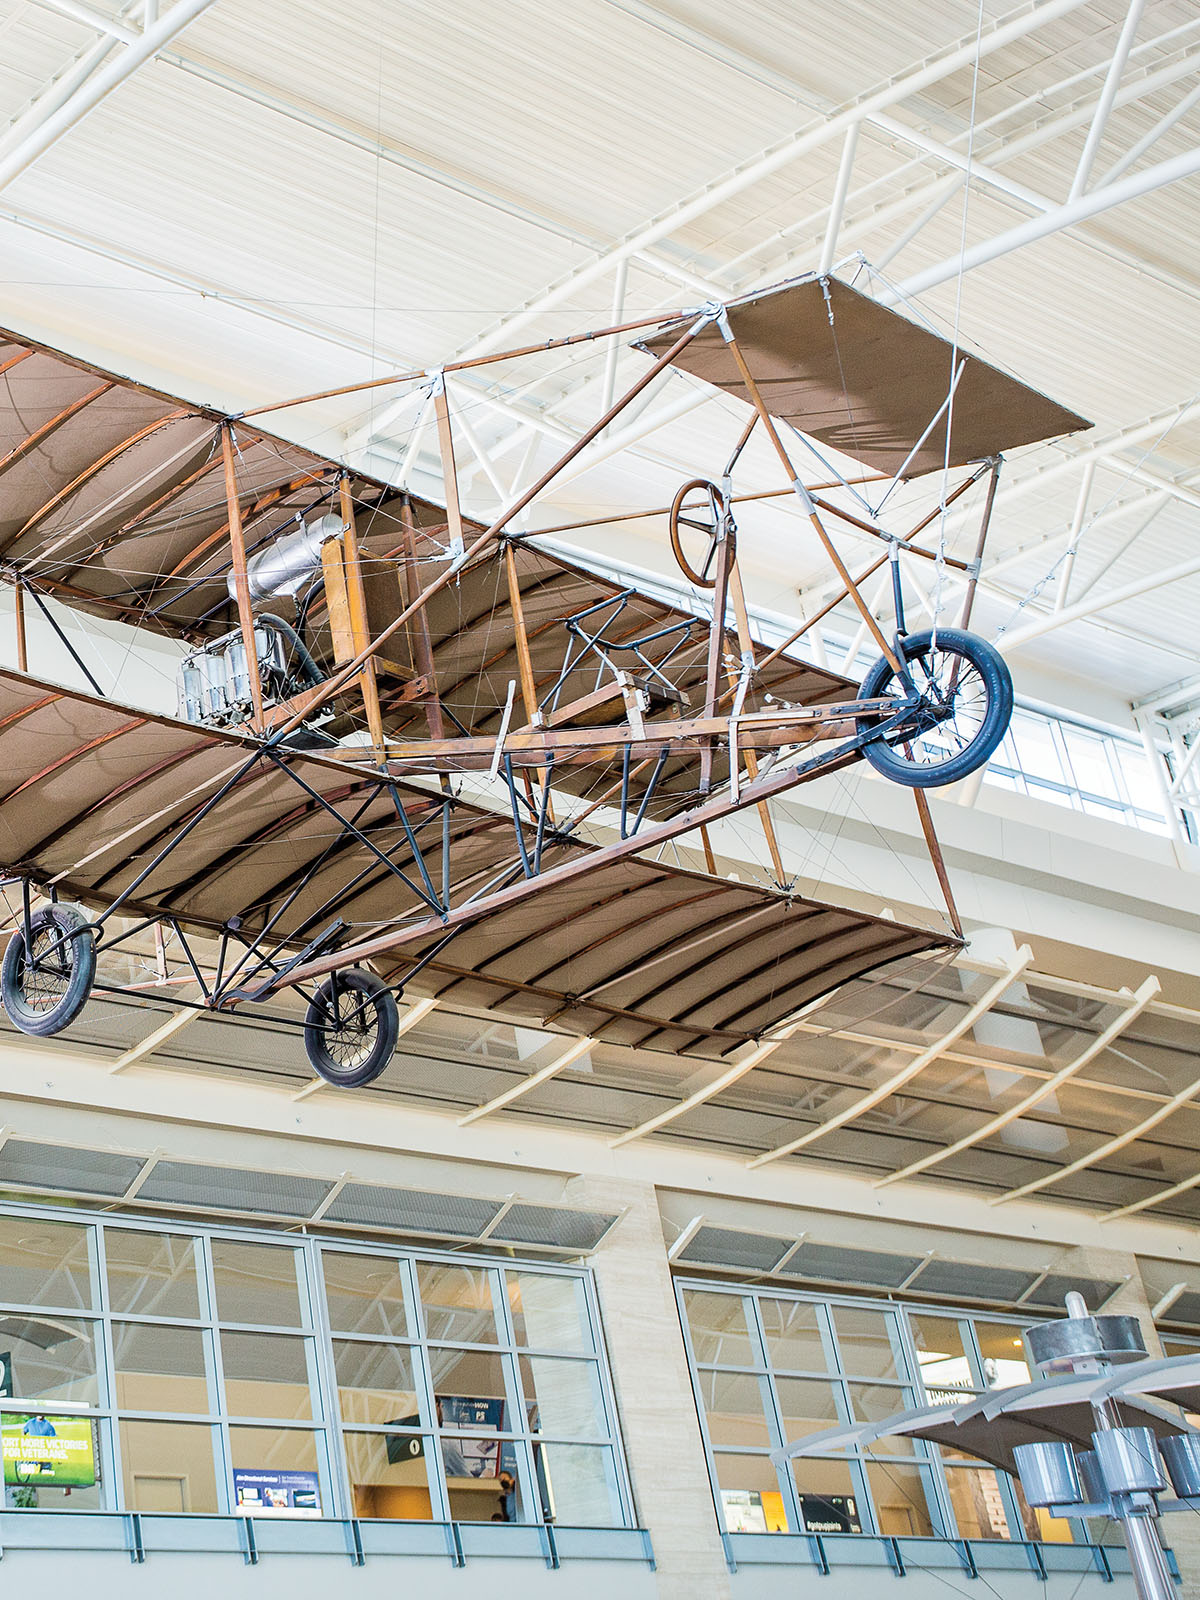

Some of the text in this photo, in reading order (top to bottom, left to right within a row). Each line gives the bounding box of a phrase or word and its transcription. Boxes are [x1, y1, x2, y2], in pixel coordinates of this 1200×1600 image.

[20, 1438, 45, 1449] MORE
[47, 1440, 88, 1450] VICTORIES
[4, 1448, 20, 1458] FOR
